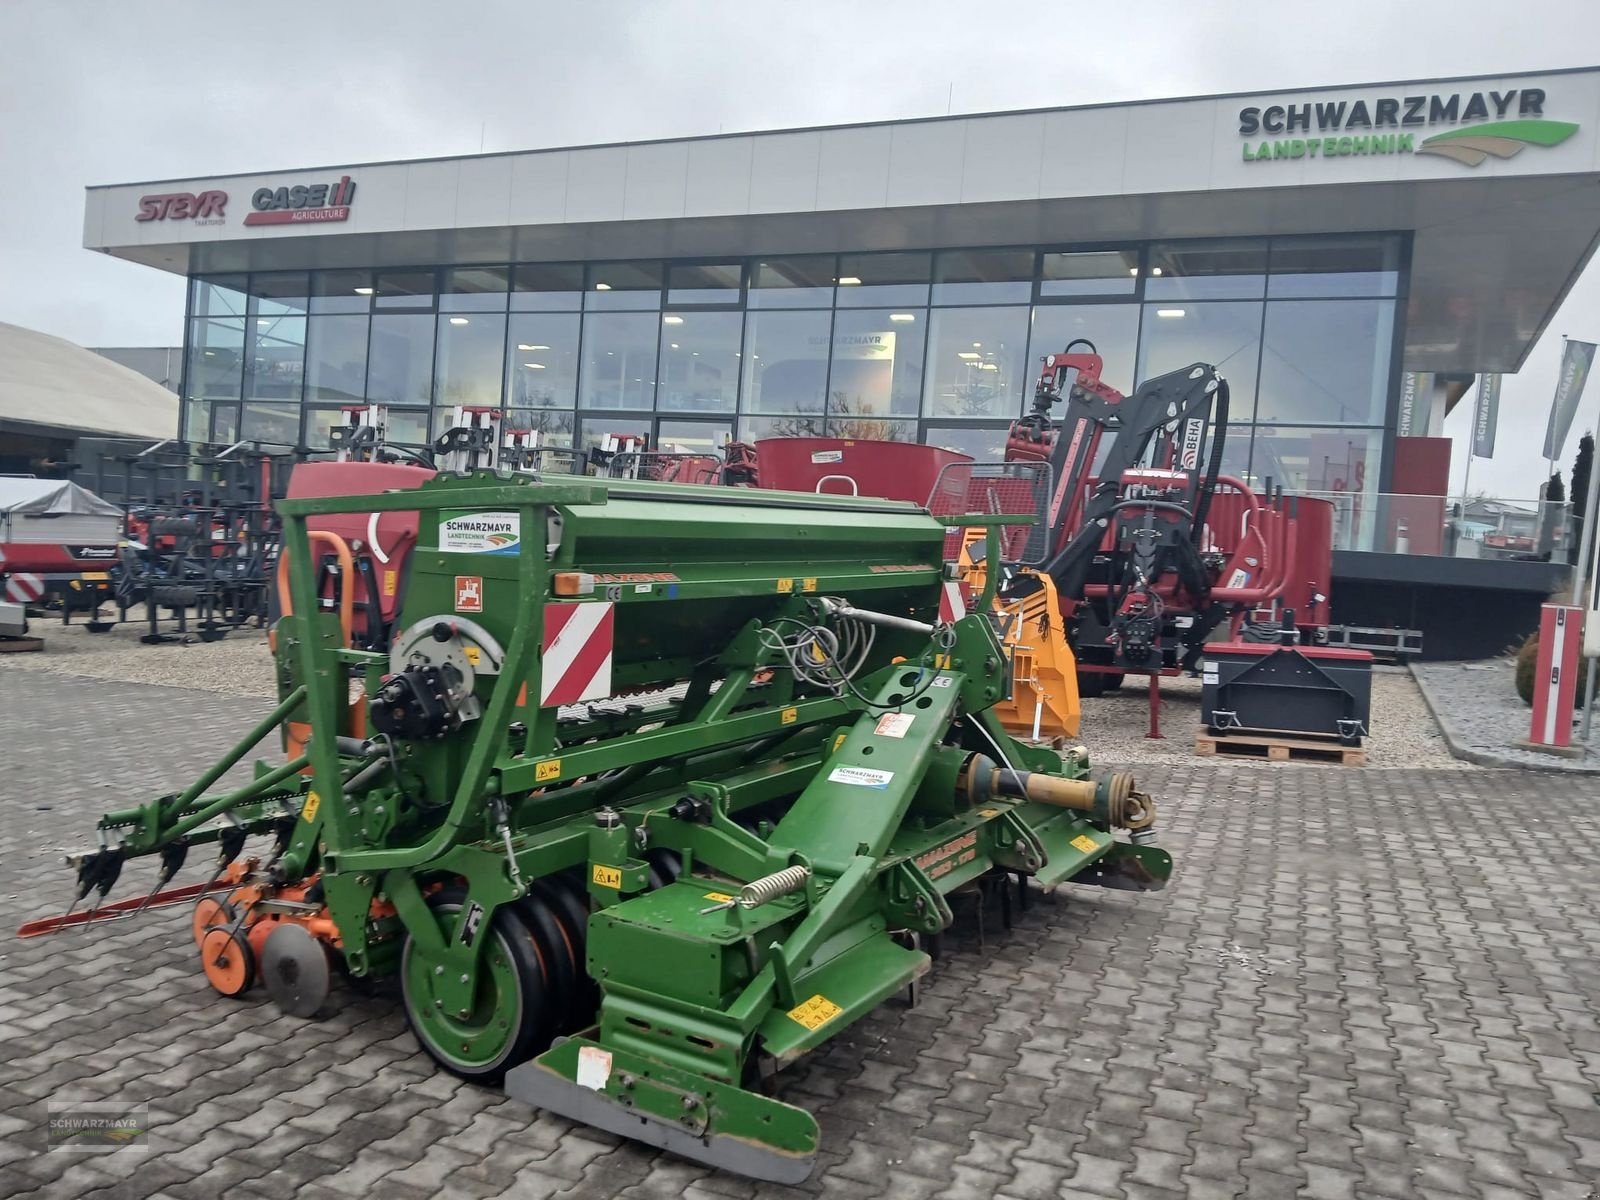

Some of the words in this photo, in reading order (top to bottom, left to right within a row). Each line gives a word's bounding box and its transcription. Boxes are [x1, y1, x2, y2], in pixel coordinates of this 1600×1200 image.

[1238, 88, 1546, 134] SCHWARZMAYR
[1241, 133, 1415, 162] LANDTECHNIK
[134, 189, 229, 222] STEYR
[251, 186, 329, 211] CASE
[291, 208, 344, 221] AGRICULTURE
[1186, 420, 1201, 450] BEHA
[446, 521, 512, 532] SCHWARZMAYR
